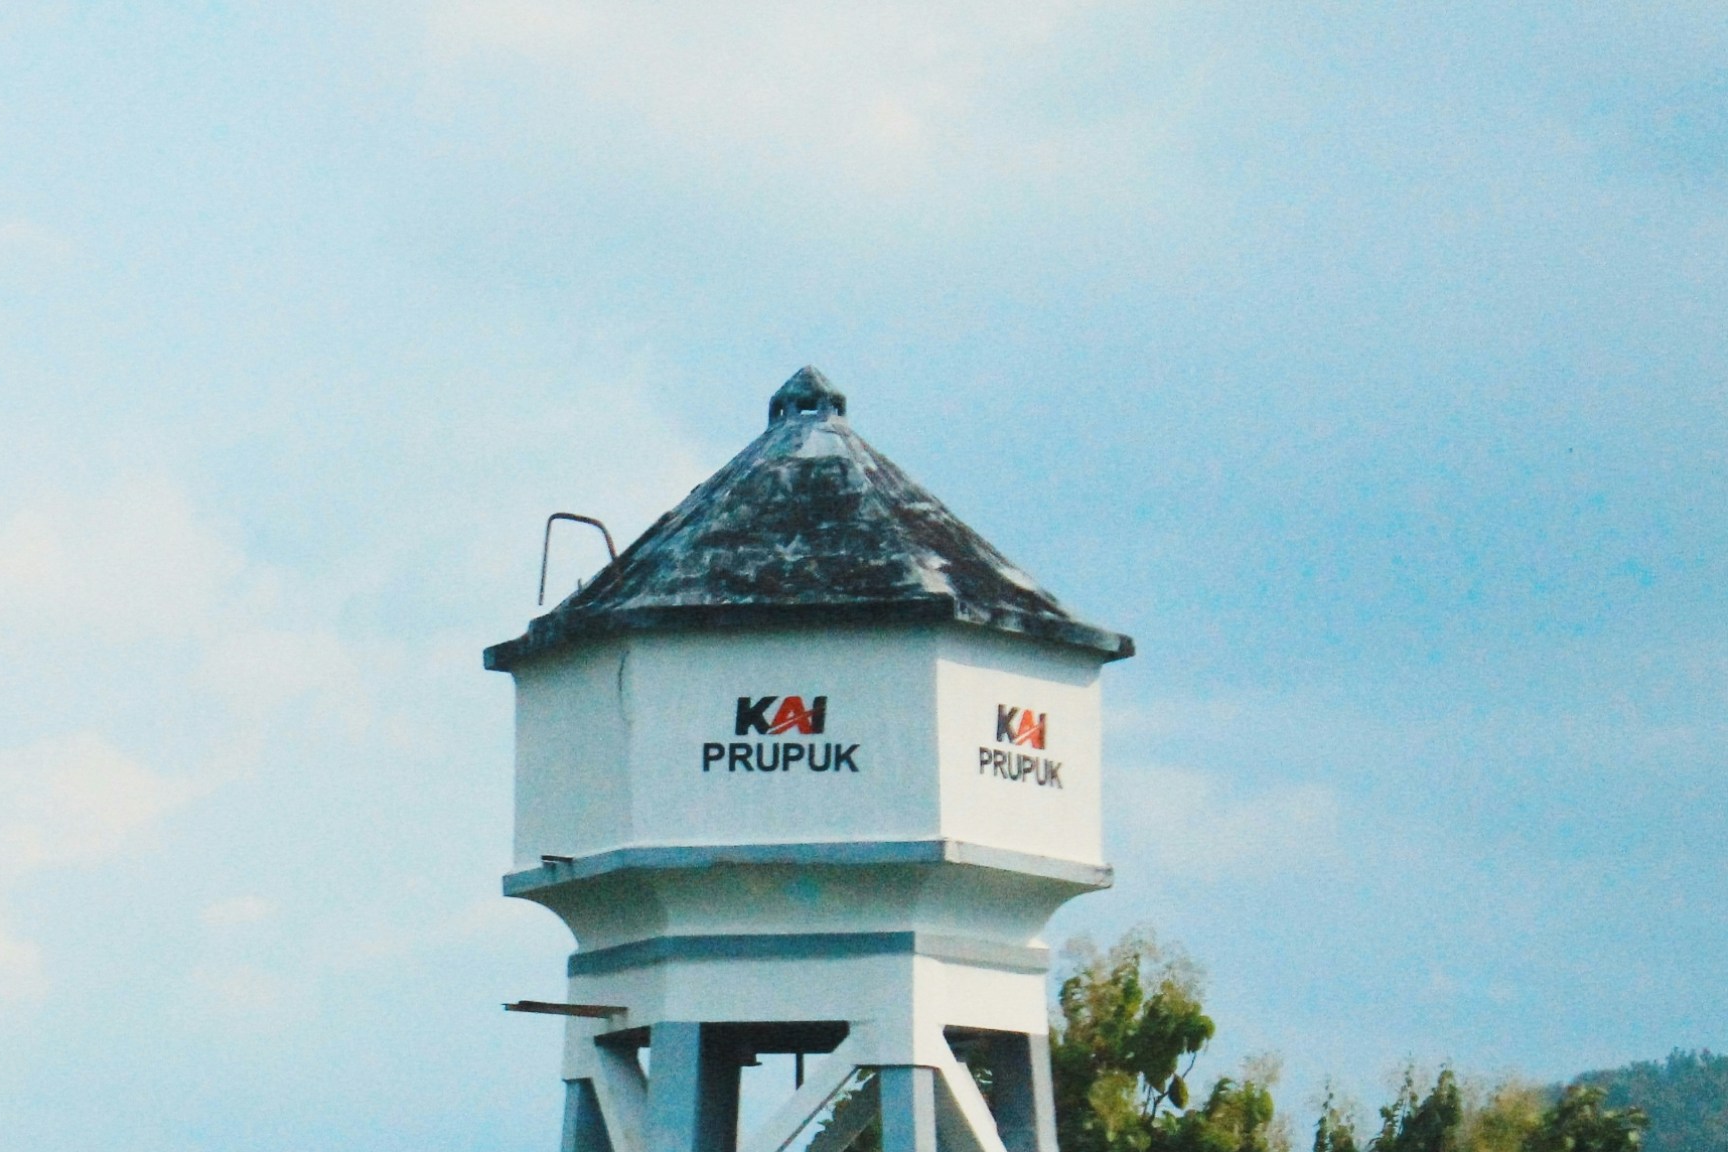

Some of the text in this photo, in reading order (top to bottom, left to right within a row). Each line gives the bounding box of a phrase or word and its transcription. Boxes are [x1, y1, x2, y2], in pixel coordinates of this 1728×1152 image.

[735, 695, 828, 736] KAI
[996, 703, 1047, 750] KAI
[702, 742, 860, 772] PRUPUK
[979, 746, 1063, 789] PRUPUK
